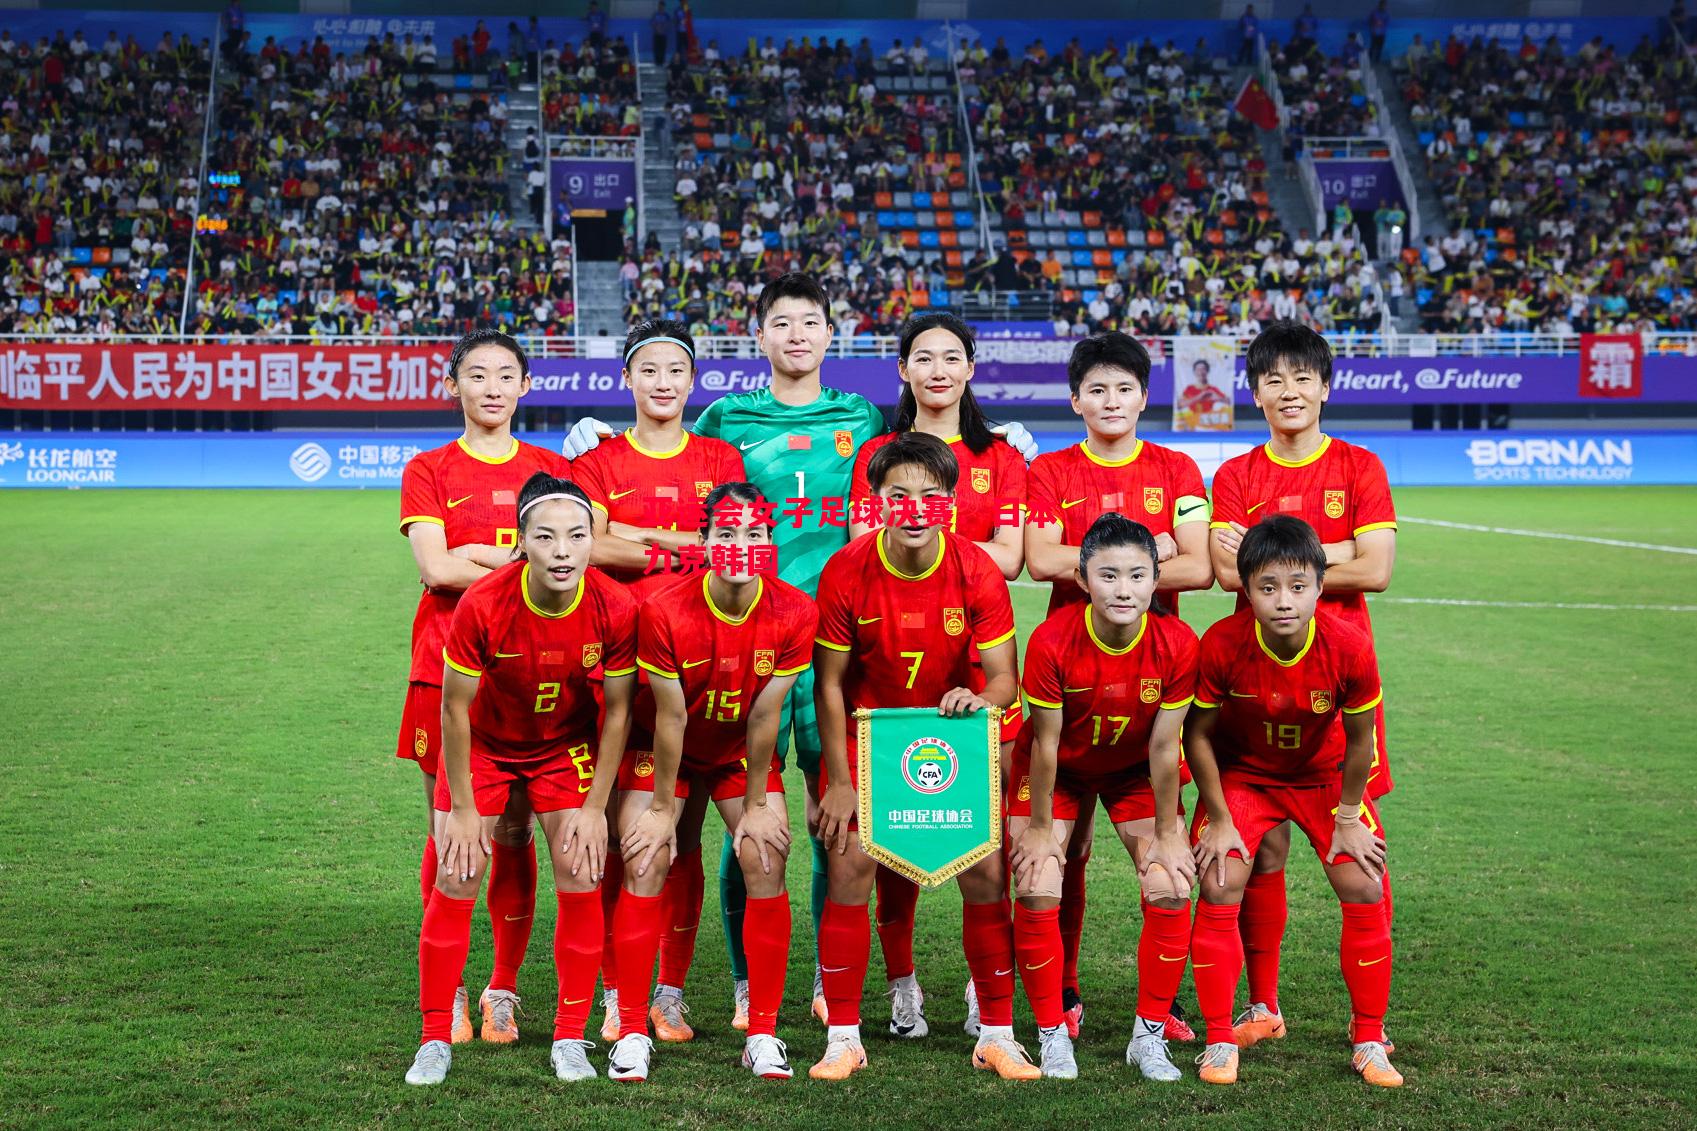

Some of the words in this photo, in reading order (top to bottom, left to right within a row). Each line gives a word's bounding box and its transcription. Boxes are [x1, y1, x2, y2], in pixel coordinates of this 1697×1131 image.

[569, 176, 583, 194] 9
[593, 174, 619, 186] 出口
[1322, 180, 1345, 195] 10
[1589, 342, 1635, 390] 霜
[530, 371, 580, 391] eart
[588, 372, 614, 391] to
[1333, 369, 1409, 393] Heart,
[1415, 368, 1523, 389] @Future
[28, 449, 117, 468] 长龙航空
[1465, 439, 1633, 466] BORNAN
[27, 470, 115, 482] LOONGAIR
[339, 466, 377, 478] China
[1473, 467, 1530, 480] SPORTS
[1535, 467, 1633, 480] TECHNOLOGY
[900, 652, 924, 689] 7
[534, 682, 560, 713] 2
[706, 689, 742, 722] 15
[1092, 715, 1131, 746] 17
[1263, 721, 1301, 749] 19
[568, 743, 595, 779] 2
[888, 809, 972, 823] 中国足球协会
